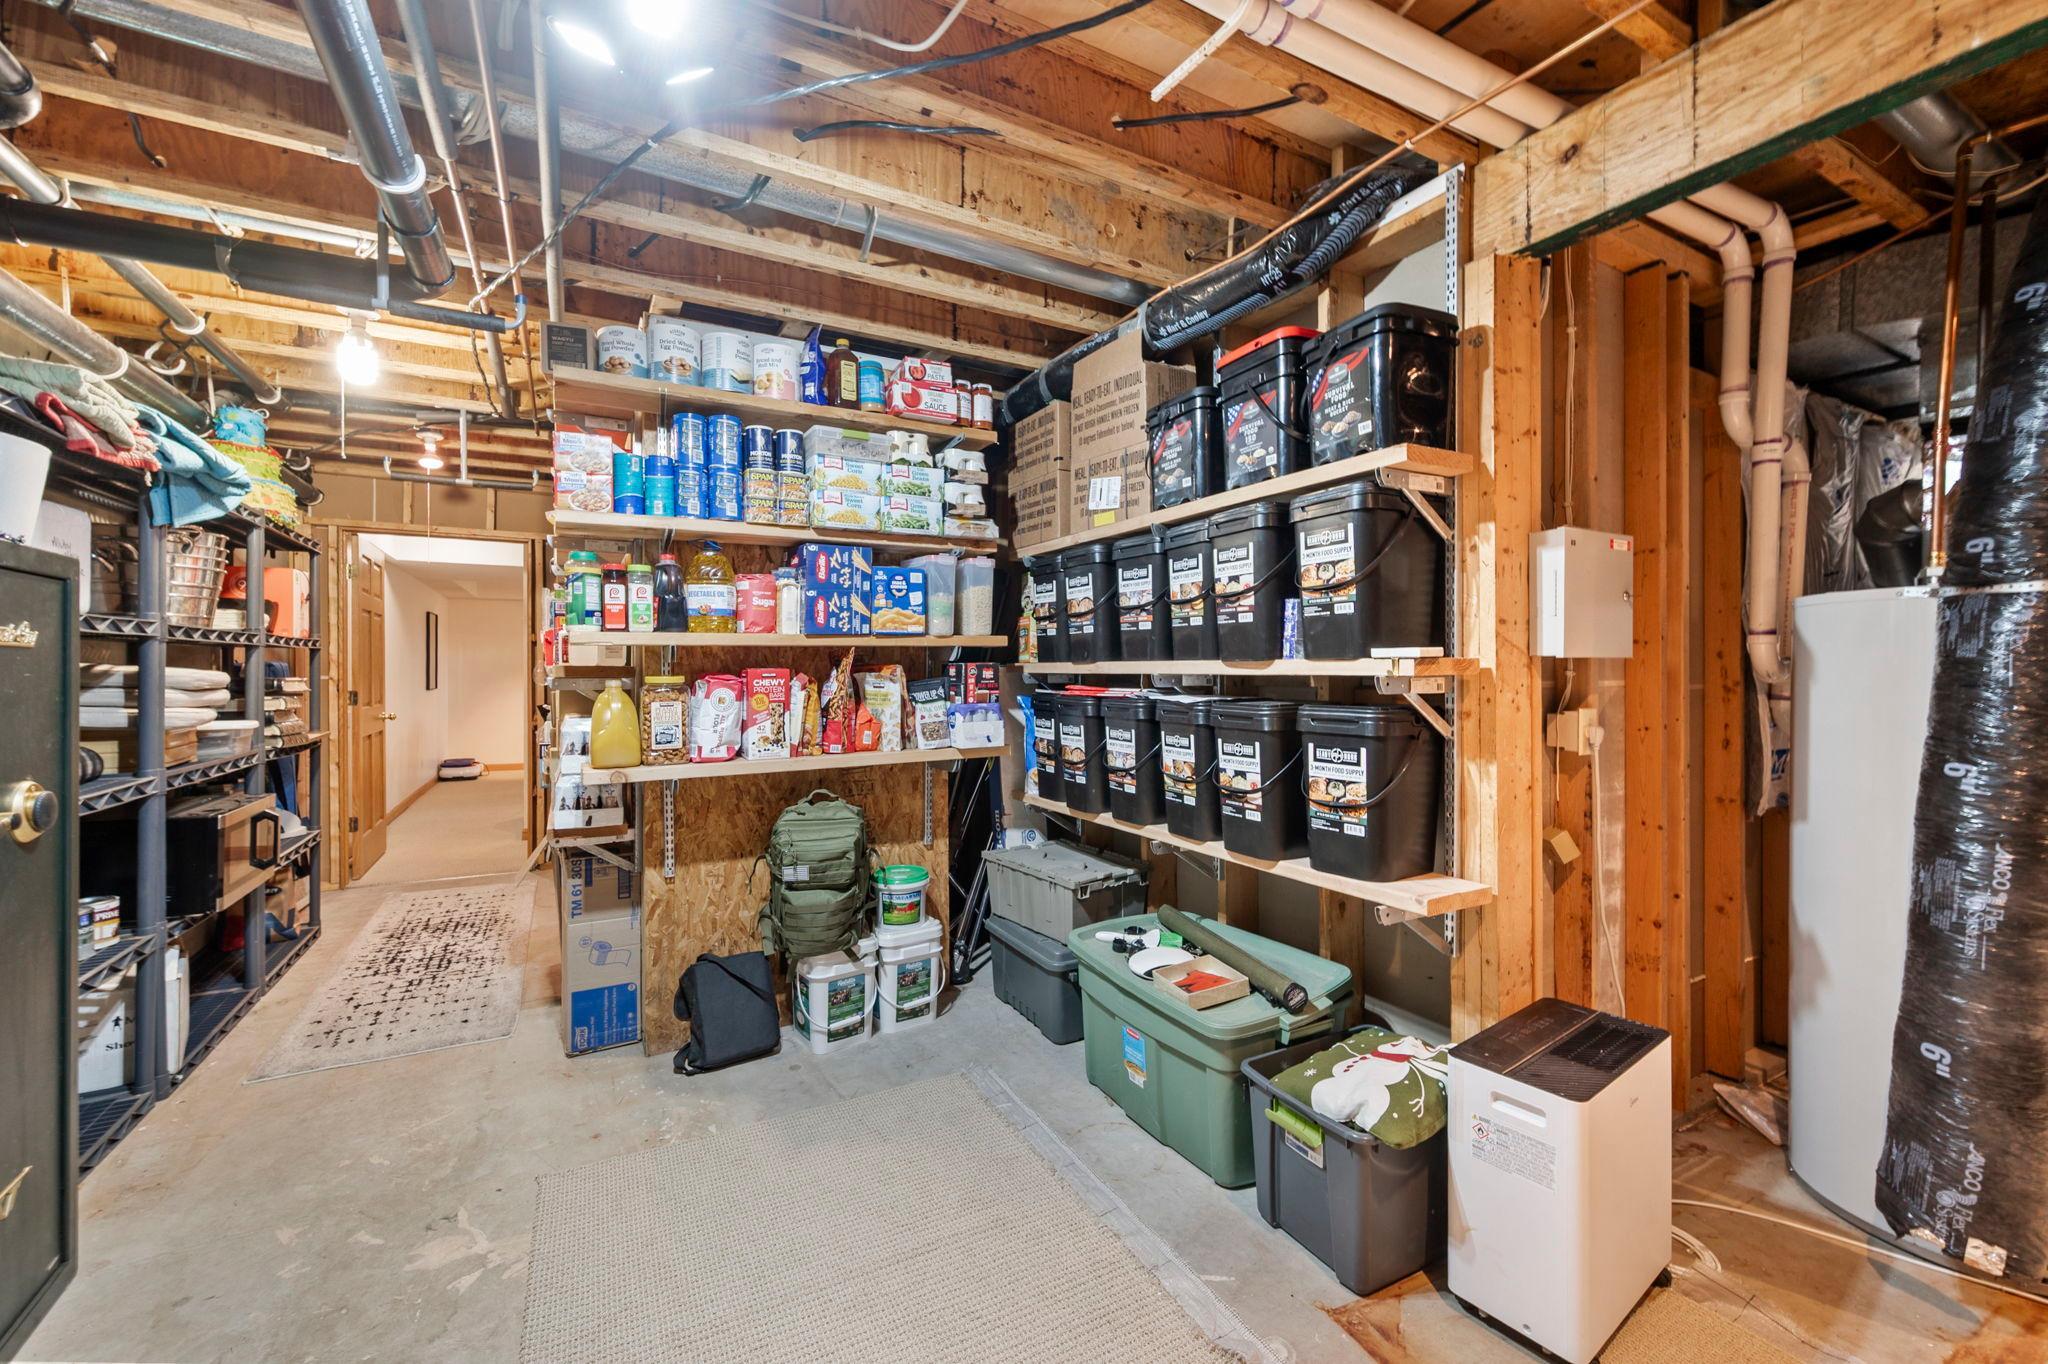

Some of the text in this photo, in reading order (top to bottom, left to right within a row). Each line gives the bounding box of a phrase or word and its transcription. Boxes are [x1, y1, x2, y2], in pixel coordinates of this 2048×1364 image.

[1166, 321, 1181, 334] Hart
[1185, 309, 1209, 325] Cooley
[551, 335, 575, 343] WAGYU
[659, 338, 695, 349] Dried Whole
[660, 344, 672, 352] Egg
[927, 373, 946, 382] PASTE
[1114, 370, 1143, 392] INDIVIDUAL
[1324, 382, 1355, 400] SURVIVAL
[1331, 392, 1347, 404] FOOD
[924, 402, 948, 412] SAUCE
[1238, 418, 1265, 433] SURVIVAL
[750, 472, 774, 481] SPAM
[783, 475, 806, 485] SPAM
[750, 498, 774, 508] SPAM
[784, 501, 806, 510] SPAM
[807, 544, 816, 552] 6
[1334, 545, 1353, 555] SUPPLY
[1965, 537, 1996, 565] 6"
[818, 553, 826, 580] Barilla
[688, 590, 726, 598] VEGETABLE OIL
[752, 596, 776, 608] Sugar
[817, 599, 825, 624] Barilla
[753, 679, 785, 687] CHEWY
[930, 690, 938, 700] UP
[1332, 766, 1345, 774] FOOD
[1345, 767, 1365, 777] SUPPLY
[571, 859, 583, 919] TM 61 30S
[1919, 1041, 1952, 1079] 6"
[1963, 1142, 1986, 1192] ANCO
